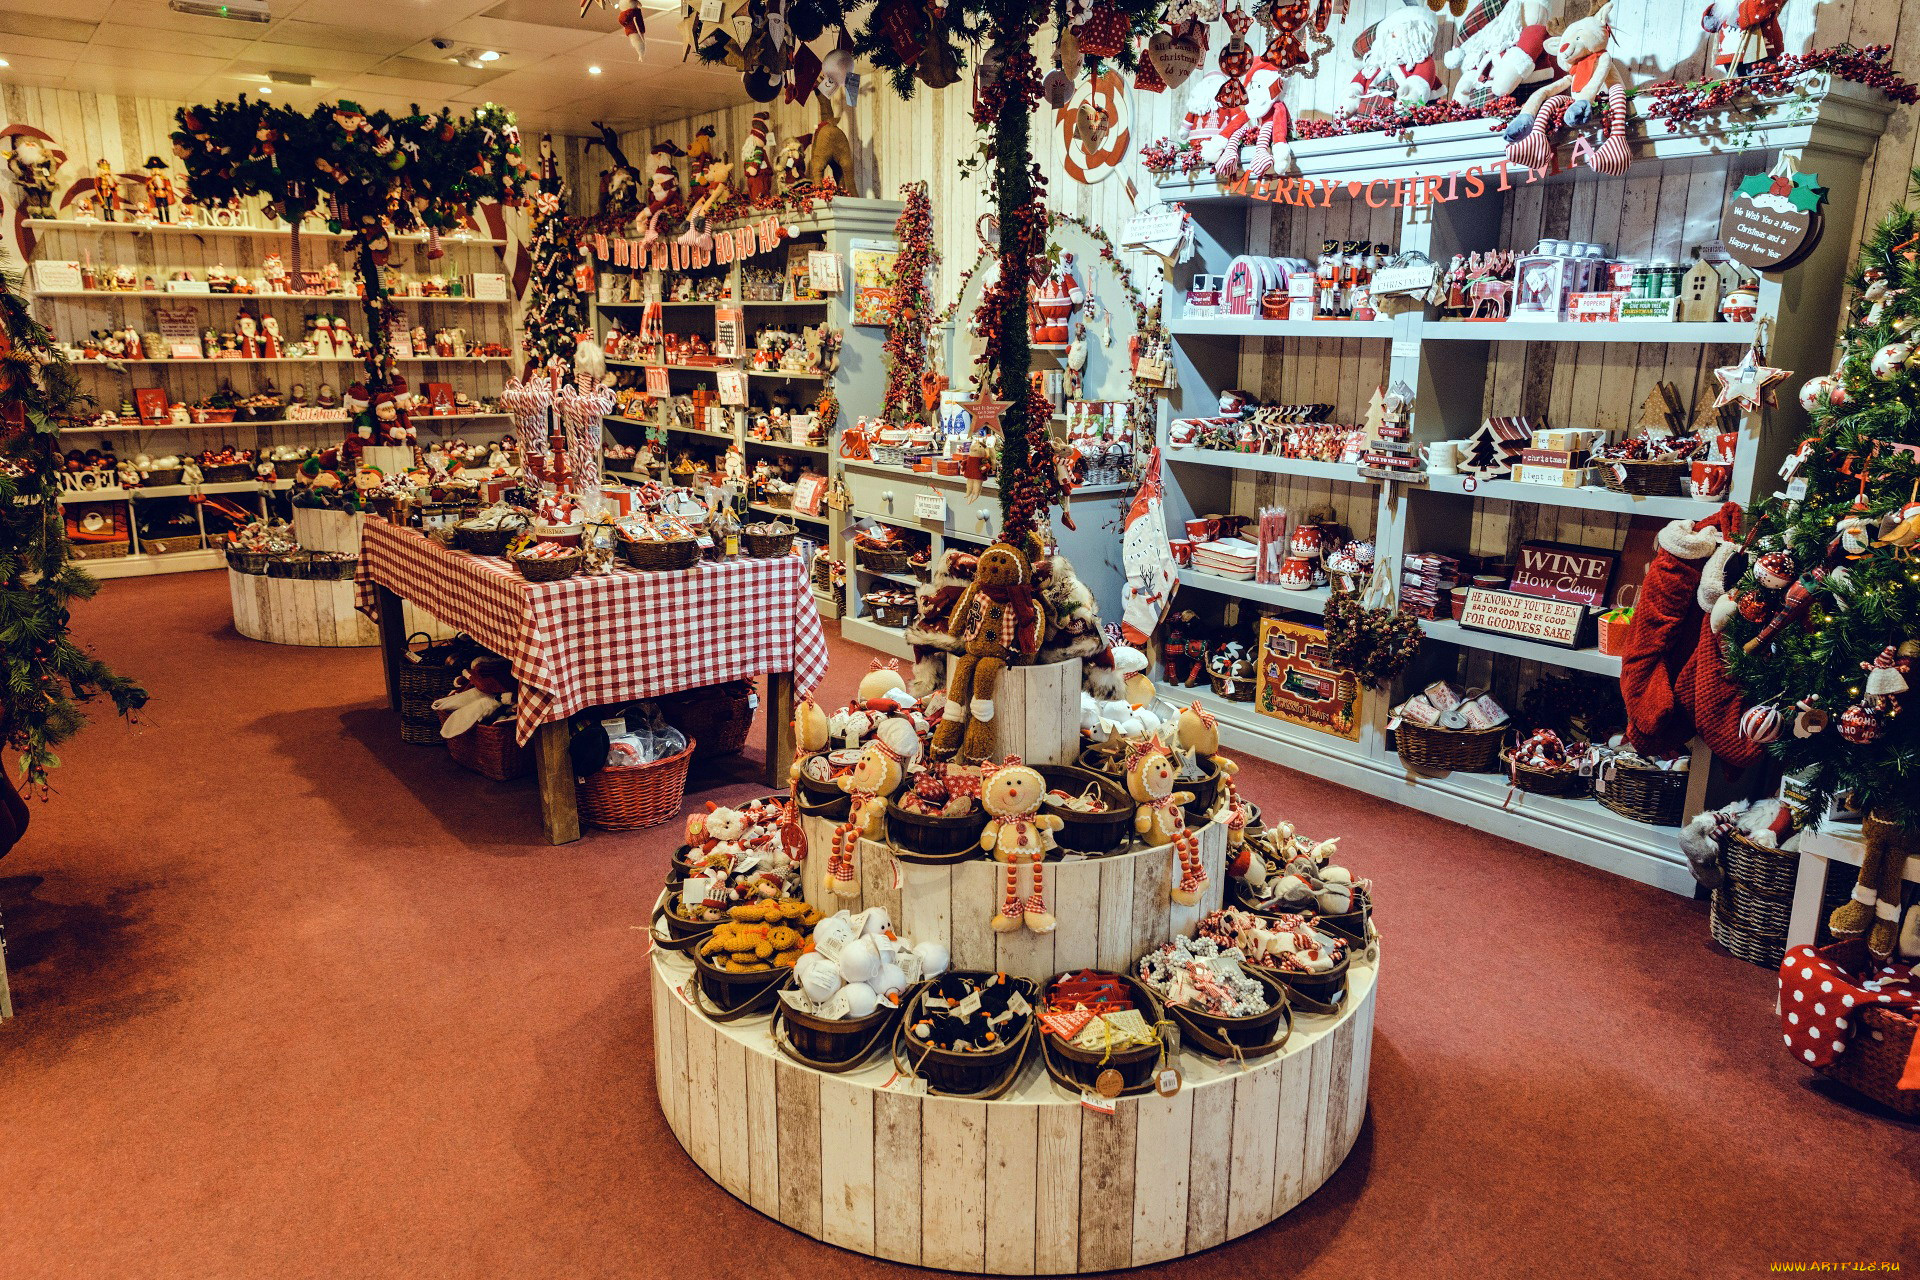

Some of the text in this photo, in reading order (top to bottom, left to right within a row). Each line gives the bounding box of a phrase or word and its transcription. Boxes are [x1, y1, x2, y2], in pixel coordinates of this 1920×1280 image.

[1223, 135, 1596, 208] MERRY CHRISTMA
[201, 208, 256, 228] NOEL
[1734, 206, 1744, 216] We
[1745, 210, 1760, 221] Wish
[1762, 214, 1773, 224] You
[1780, 220, 1802, 234] Merry
[1737, 224, 1766, 238] Christmas
[1767, 234, 1780, 243] and
[1728, 236, 1781, 259] Happy New Year
[1378, 278, 1427, 290] CHRISTMAS
[290, 404, 348, 420] Christmas
[1527, 454, 1568, 464] christmas
[62, 470, 122, 491] NOEL
[1518, 472, 1544, 480] silent
[1522, 549, 1606, 580] WINE
[1556, 576, 1597, 602] Classy
[1470, 592, 1578, 618] HE KNOWS IF YOU'VE BEEN
[1472, 604, 1486, 612] BAD
[1534, 614, 1543, 622] BE
[1545, 616, 1566, 626] GOOD
[1464, 612, 1572, 641] FOR GOODNESS SAKE
[1304, 703, 1330, 721] TRAIN
[1844, 726, 1856, 734] HO
